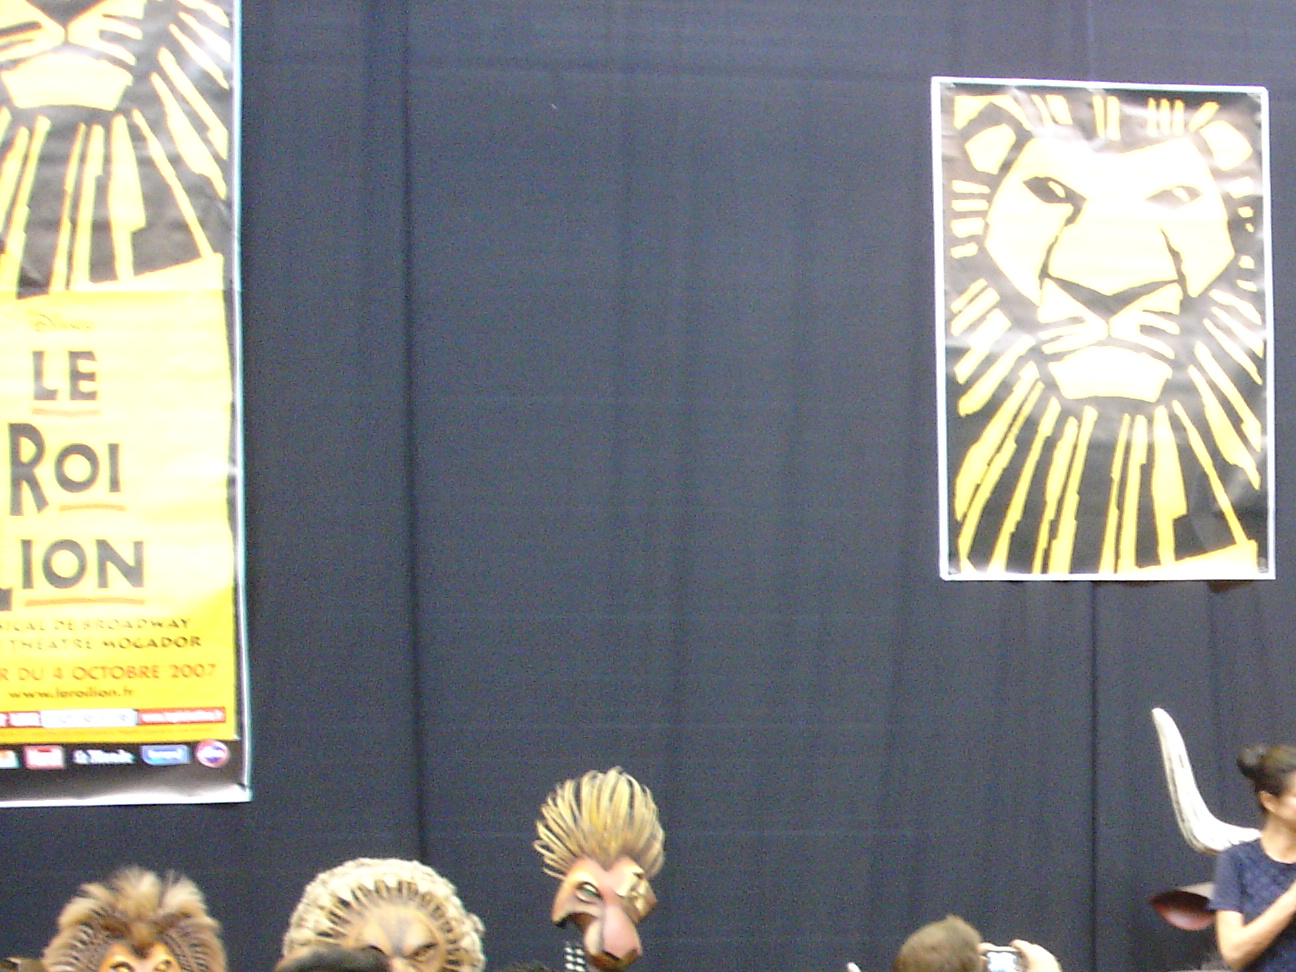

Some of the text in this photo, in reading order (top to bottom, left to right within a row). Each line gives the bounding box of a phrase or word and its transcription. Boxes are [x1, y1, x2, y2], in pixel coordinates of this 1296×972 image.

[32, 350, 98, 401] LE
[8, 422, 122, 516] ROI
[102, 635, 202, 650] MOGADOR
[18, 667, 44, 681] DU
[71, 664, 161, 682] OCTOBRE
[168, 662, 217, 679] 2007
